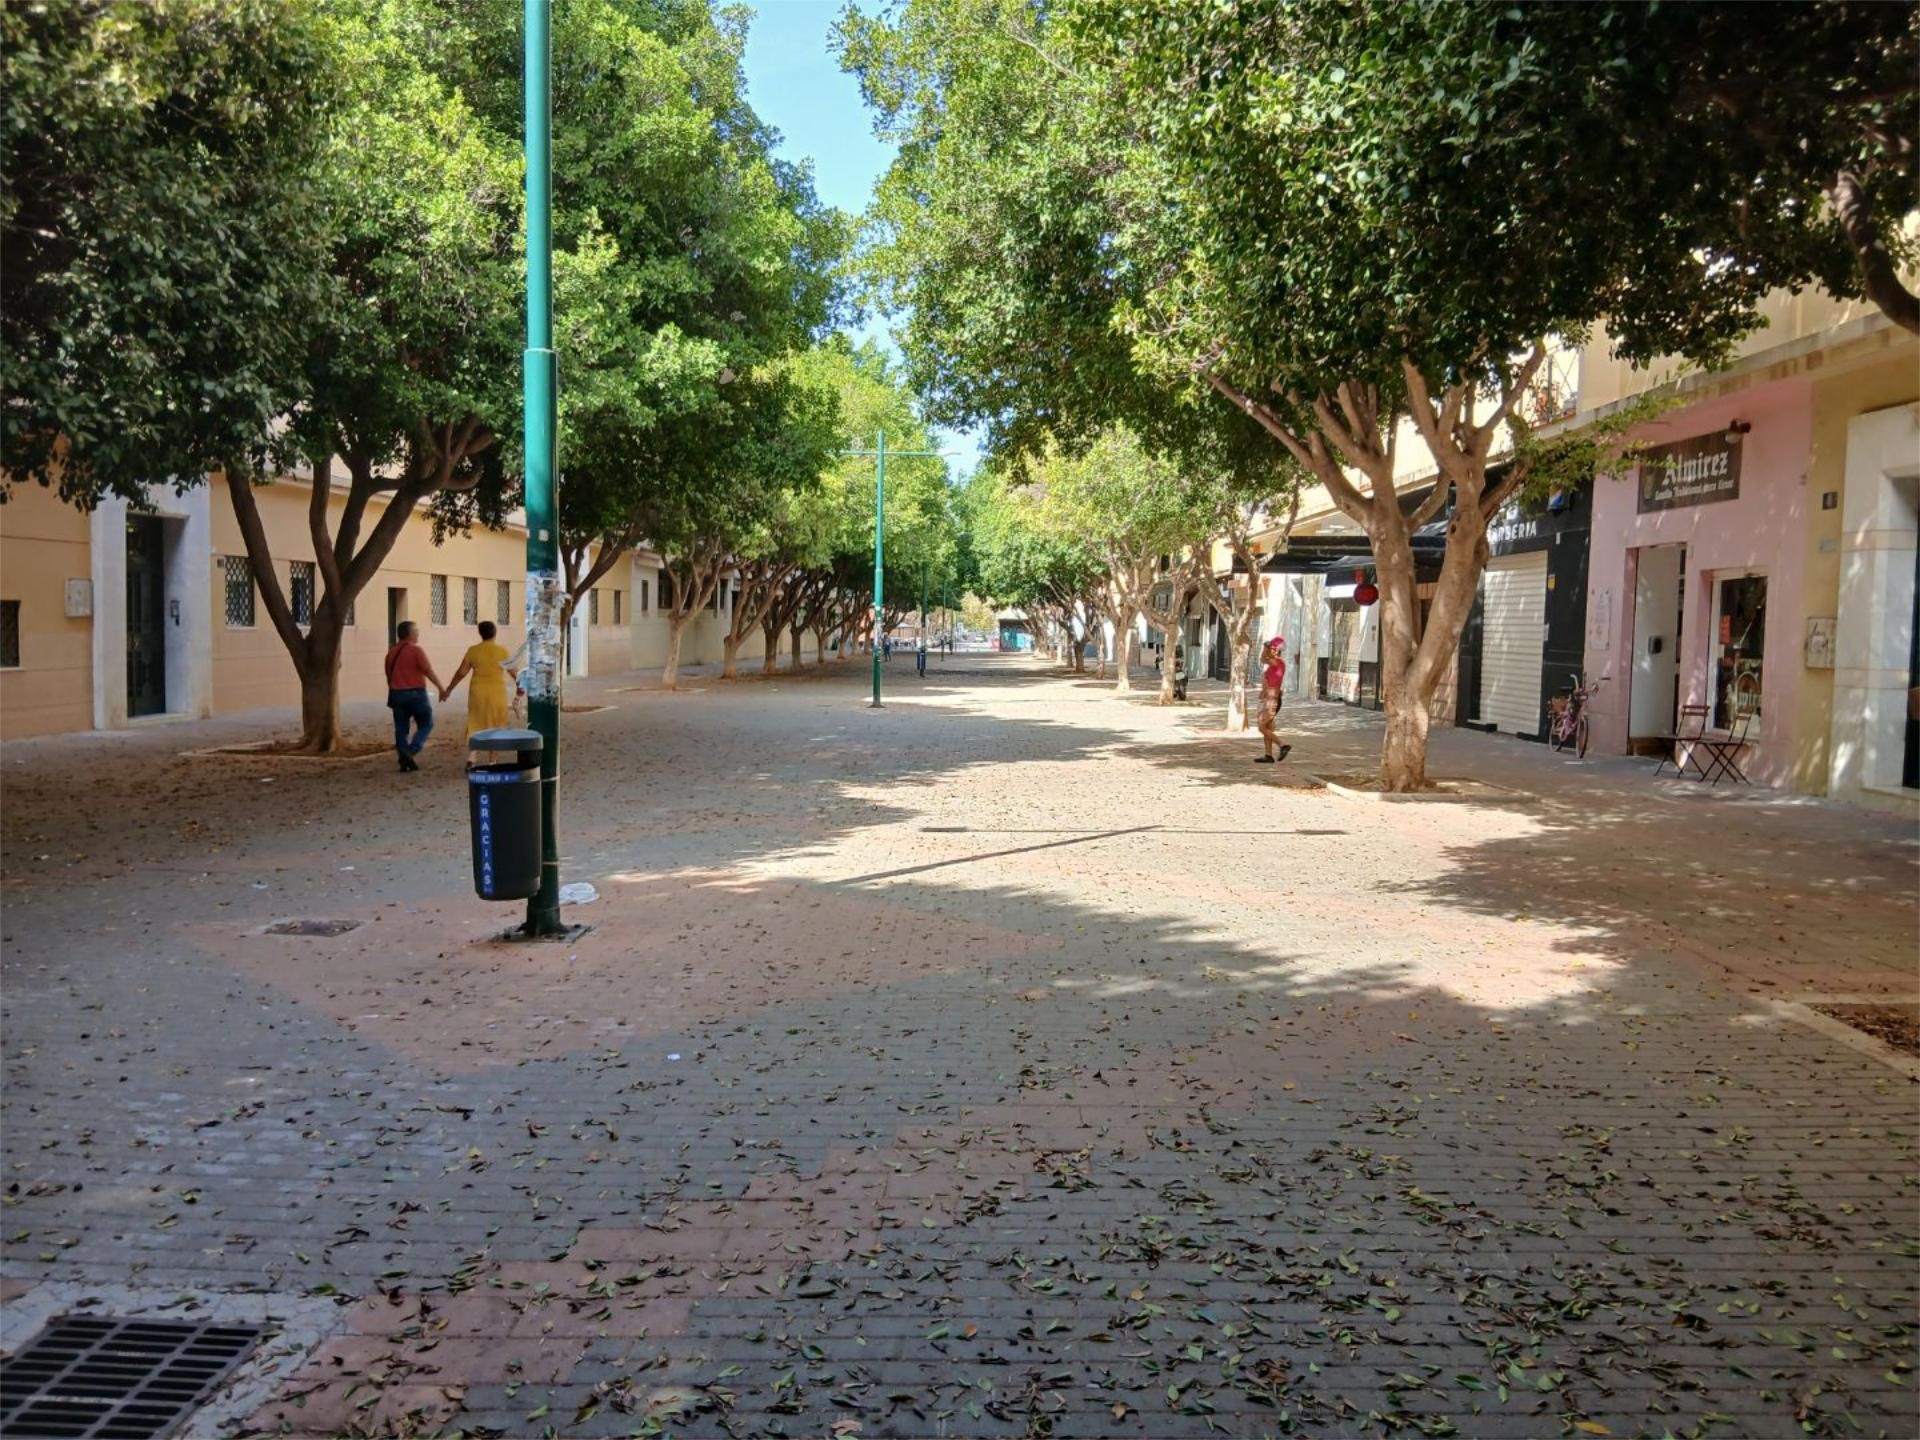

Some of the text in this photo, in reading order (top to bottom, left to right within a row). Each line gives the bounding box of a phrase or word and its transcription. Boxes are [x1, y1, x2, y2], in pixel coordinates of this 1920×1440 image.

[1662, 451, 1728, 486] Almirez
[1488, 520, 1537, 543] ARBERIA
[480, 794, 492, 885] GRACIAS
